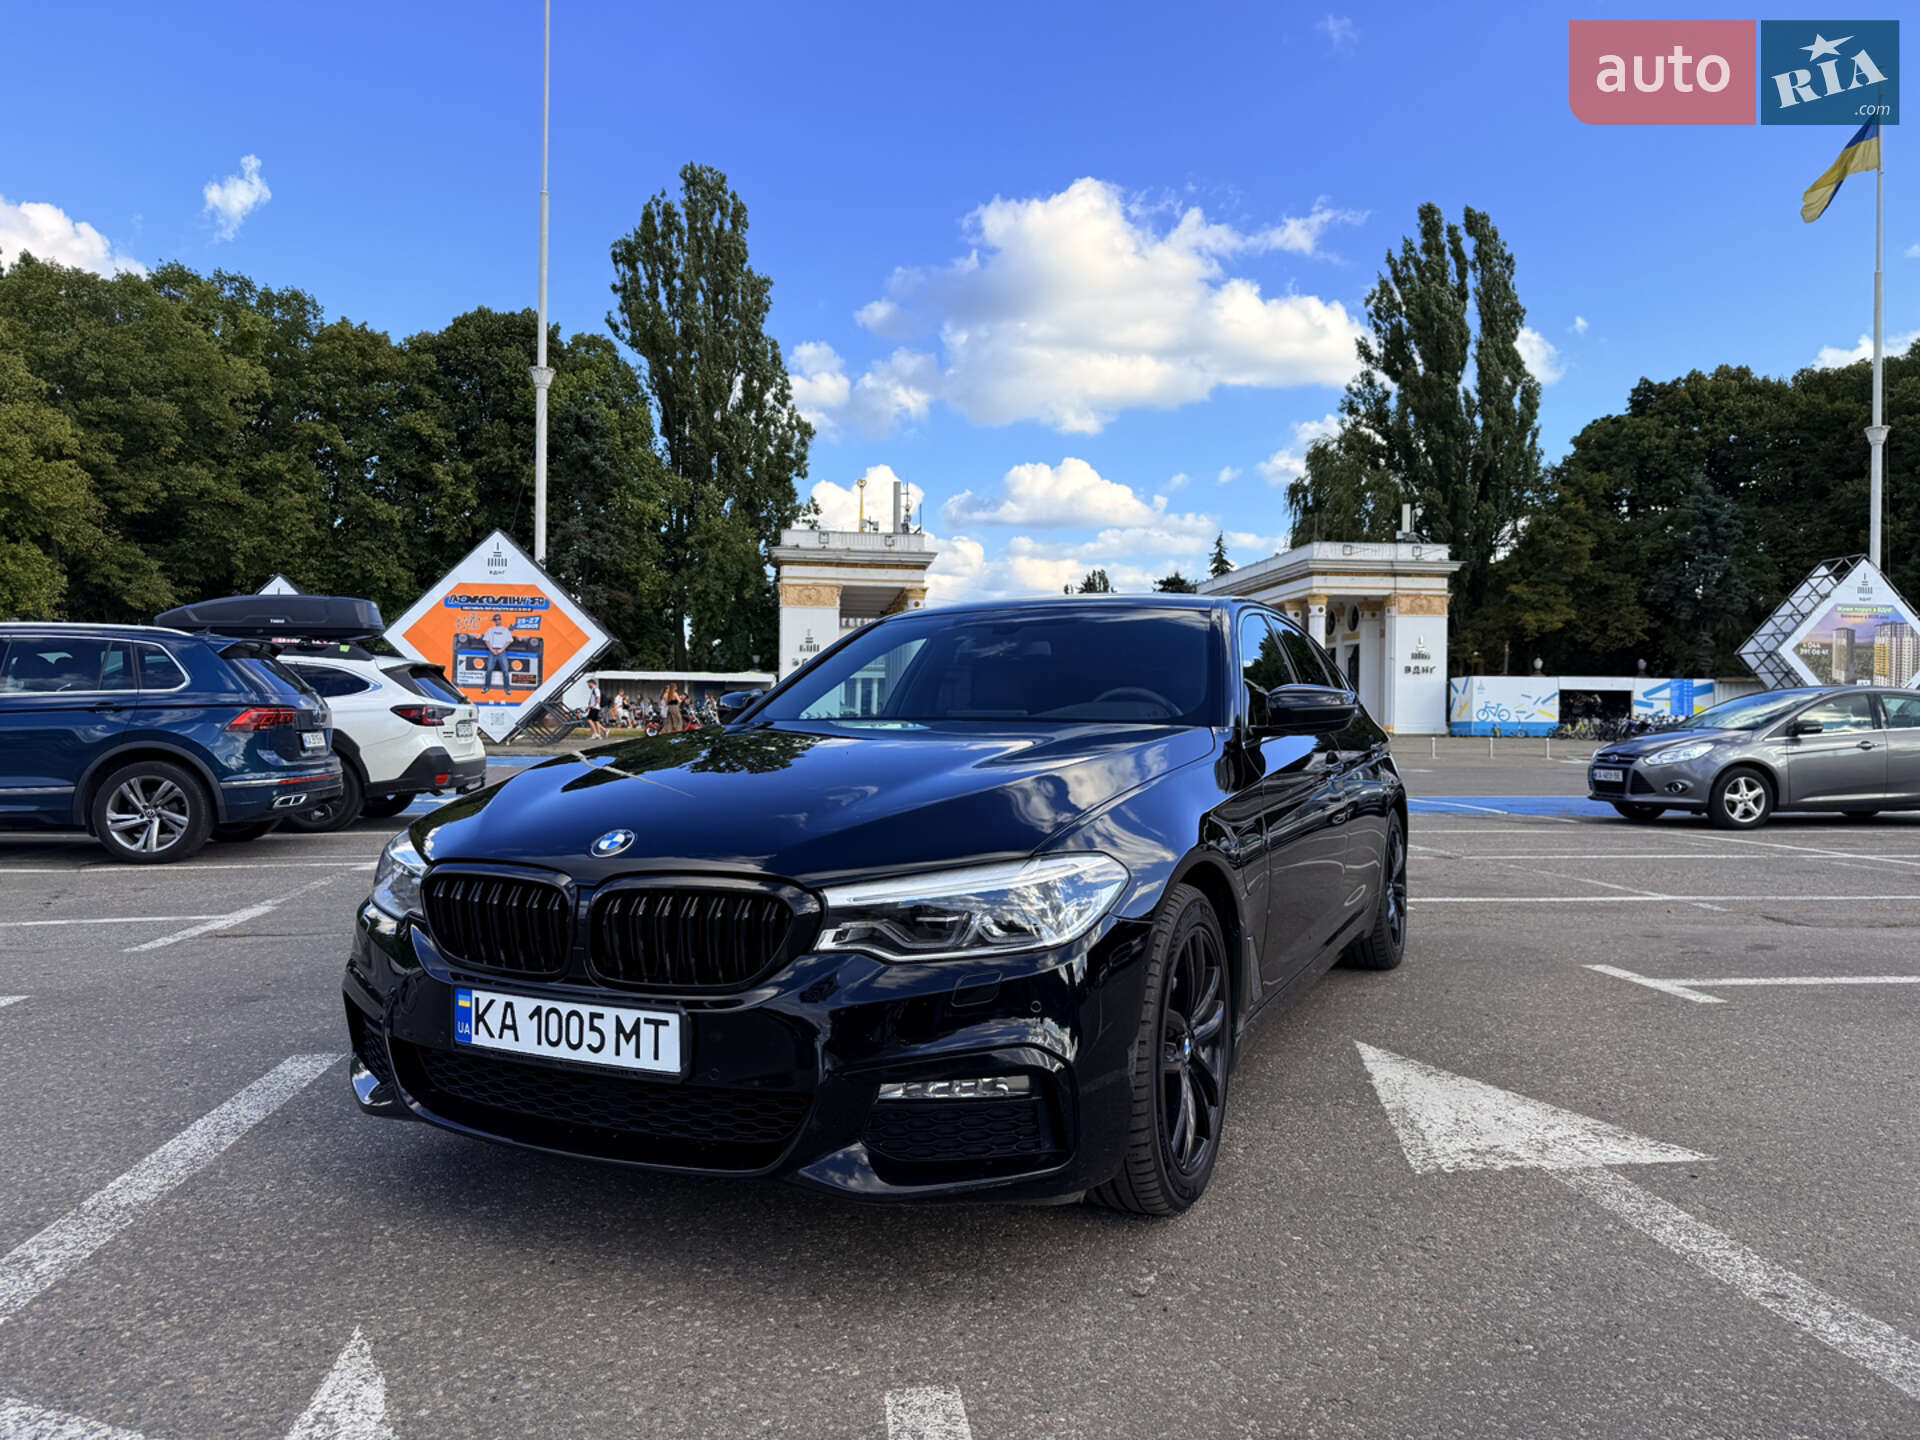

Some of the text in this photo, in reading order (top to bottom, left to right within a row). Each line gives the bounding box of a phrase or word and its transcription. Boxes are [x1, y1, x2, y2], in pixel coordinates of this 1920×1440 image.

[458, 1021, 471, 1036] UA
[474, 997, 671, 1061] KA 1005 MT
